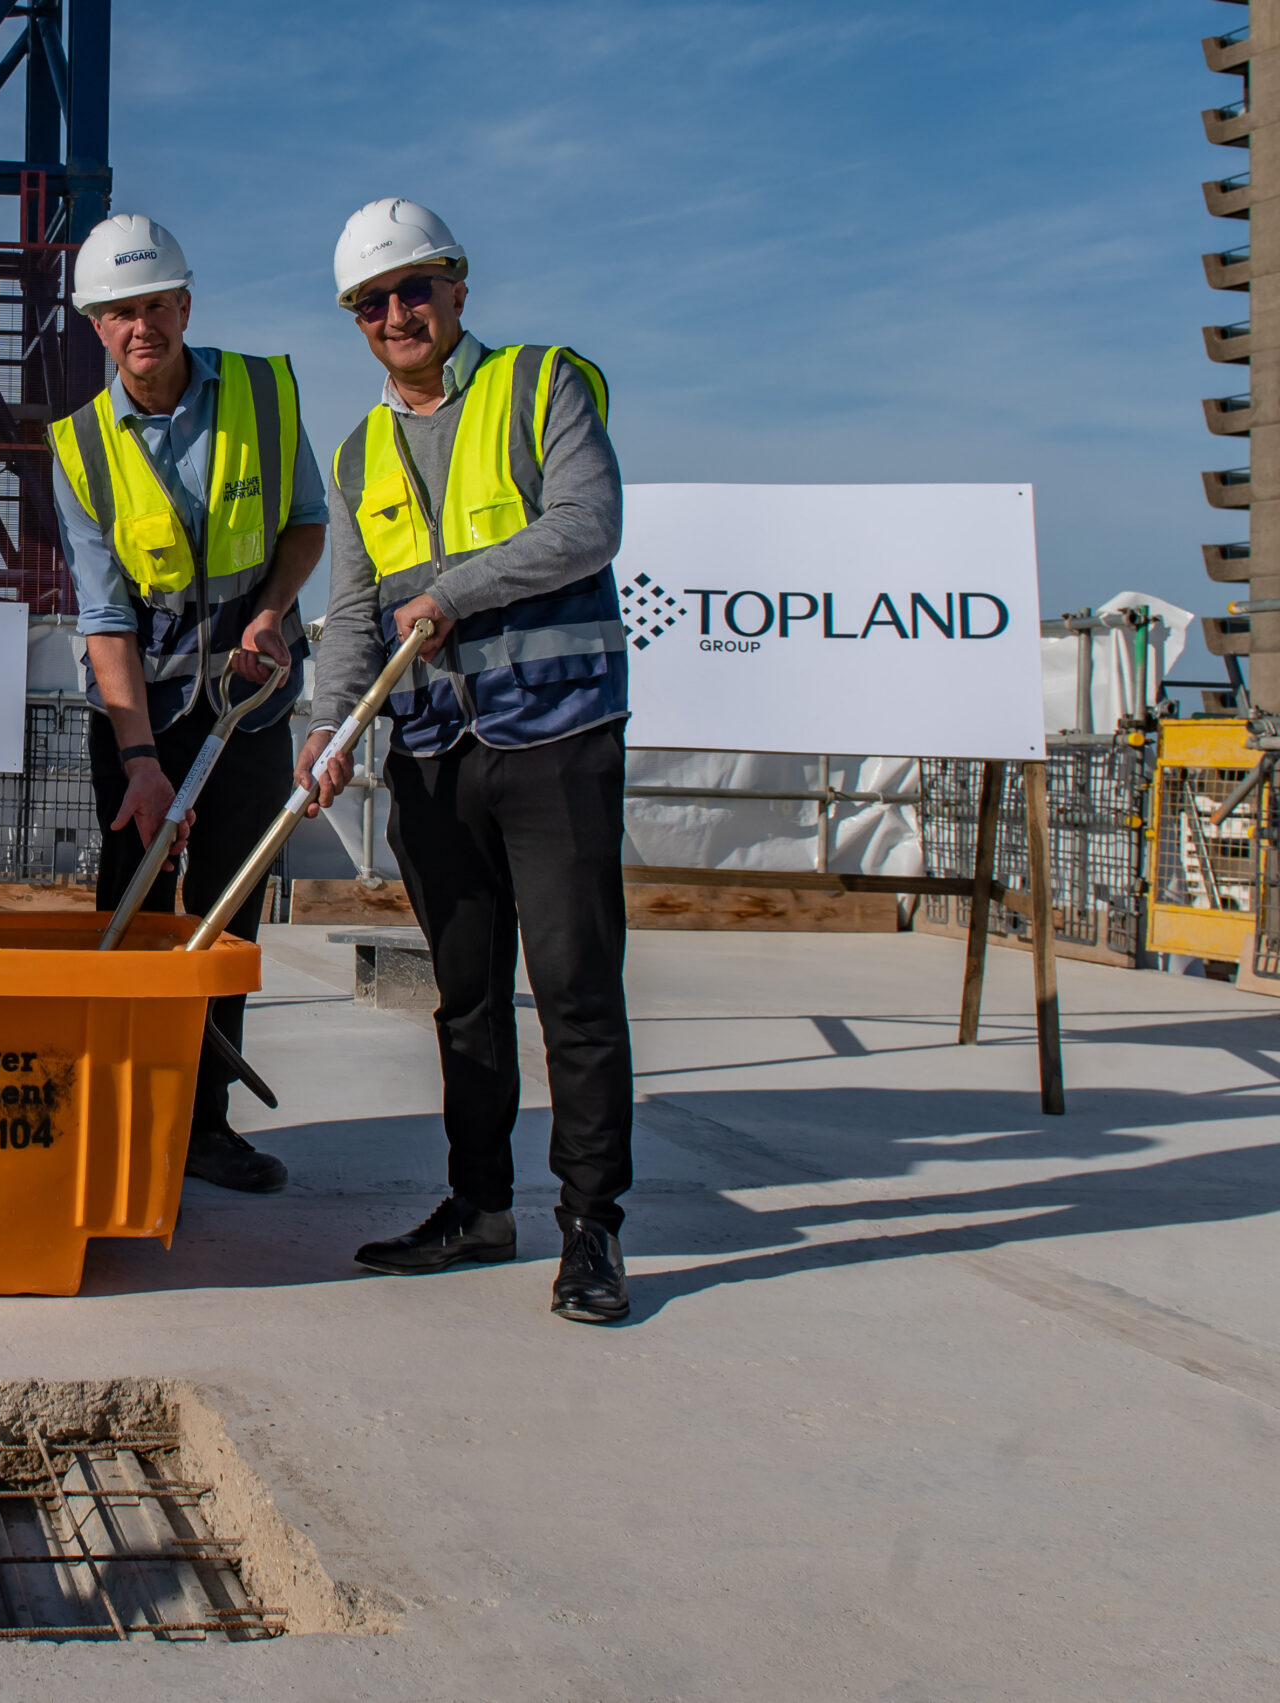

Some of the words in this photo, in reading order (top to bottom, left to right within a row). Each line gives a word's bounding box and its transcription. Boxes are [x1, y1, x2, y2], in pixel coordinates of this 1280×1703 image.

[114, 251, 157, 266] MIDGARD
[683, 588, 1010, 640] TOPLAND
[699, 639, 761, 653] GROUP
